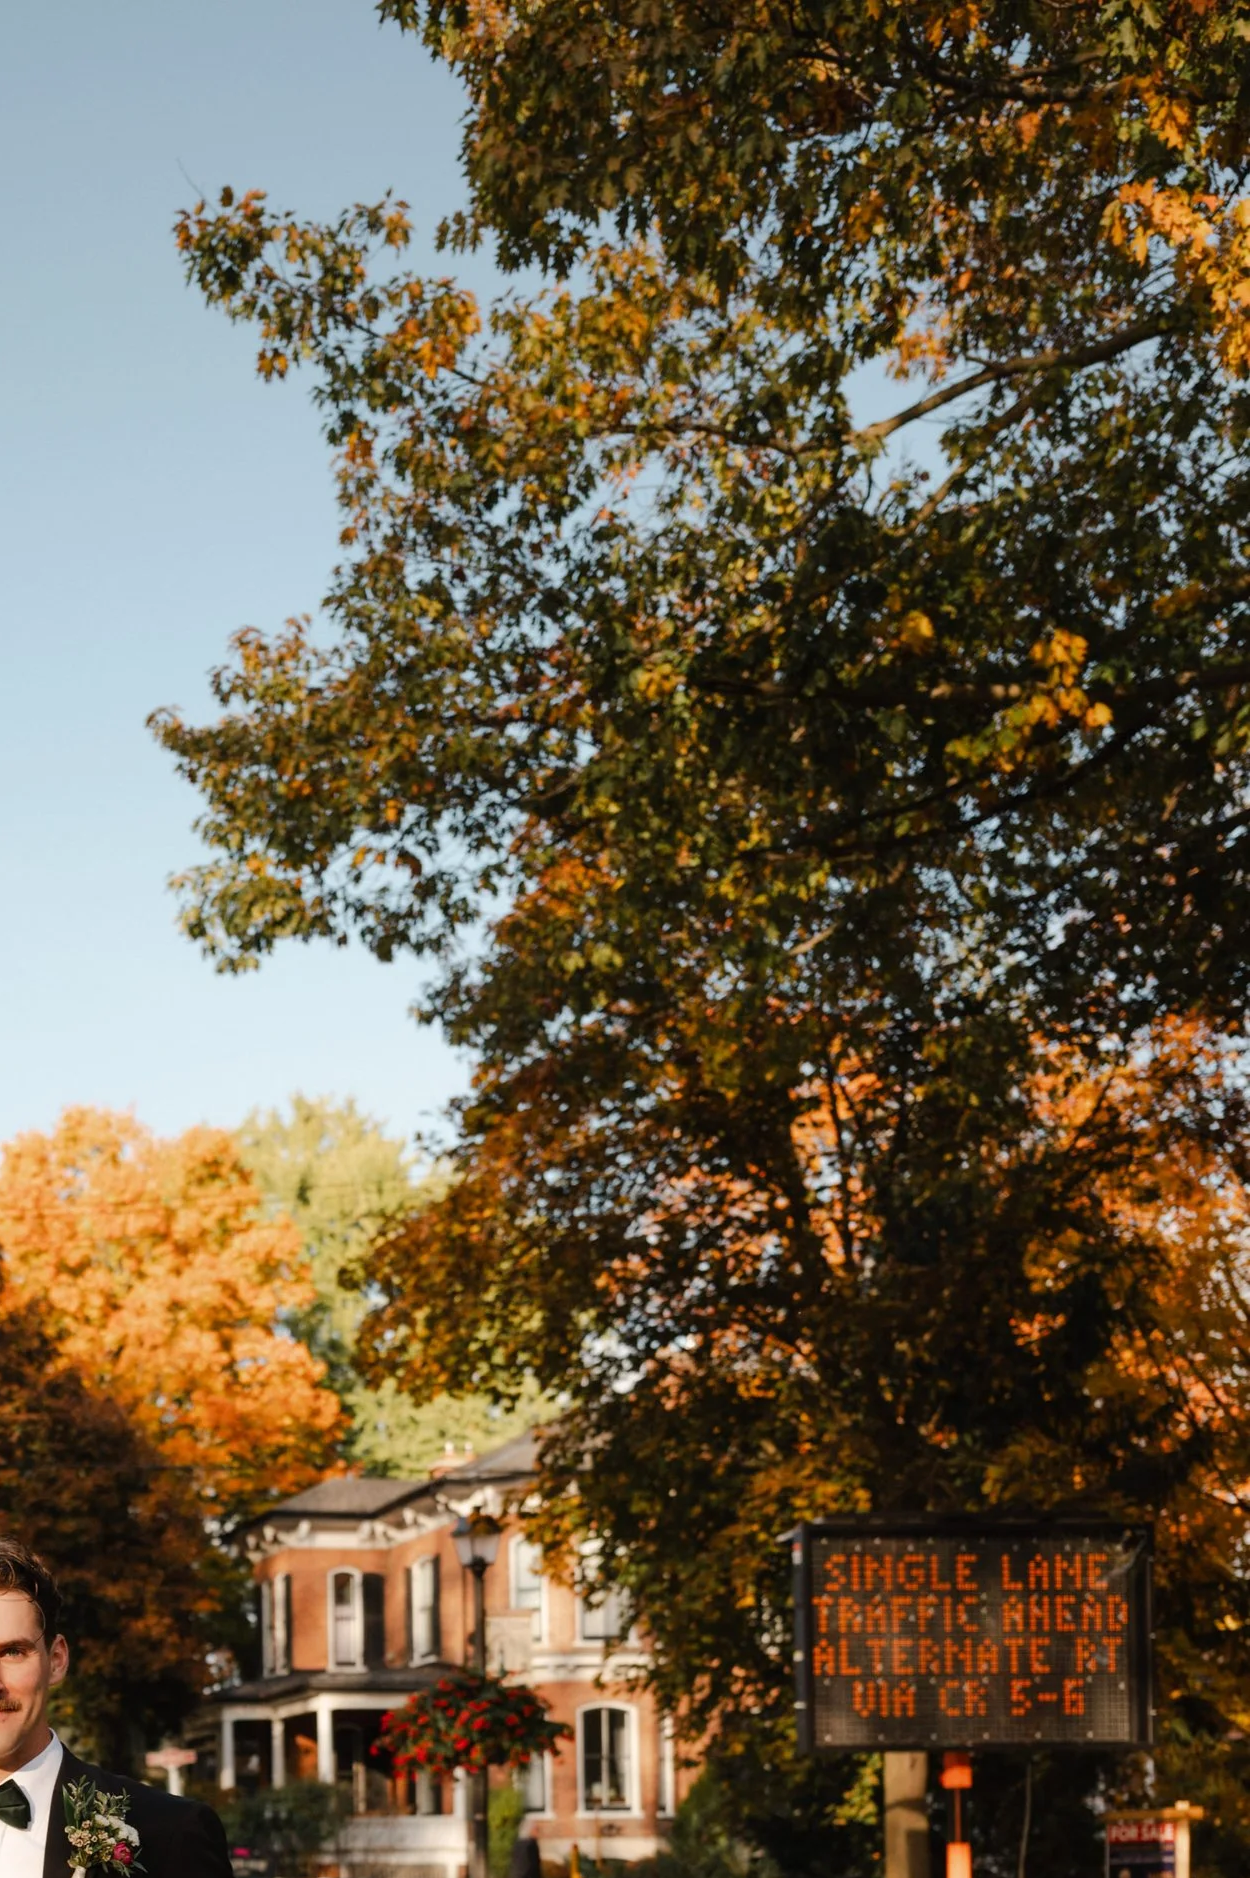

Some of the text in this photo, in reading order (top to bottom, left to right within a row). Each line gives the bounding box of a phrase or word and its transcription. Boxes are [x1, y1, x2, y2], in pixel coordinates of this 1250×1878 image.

[823, 1553, 1108, 1591] SINGLE LANE
[812, 1594, 1129, 1633] TRAFFIC AHEAD
[812, 1636, 1124, 1676] ALTERNATE RT
[852, 1679, 915, 1718] VIA
[938, 1678, 987, 1717] CR
[1110, 1823, 1174, 1841] FOR SALE
